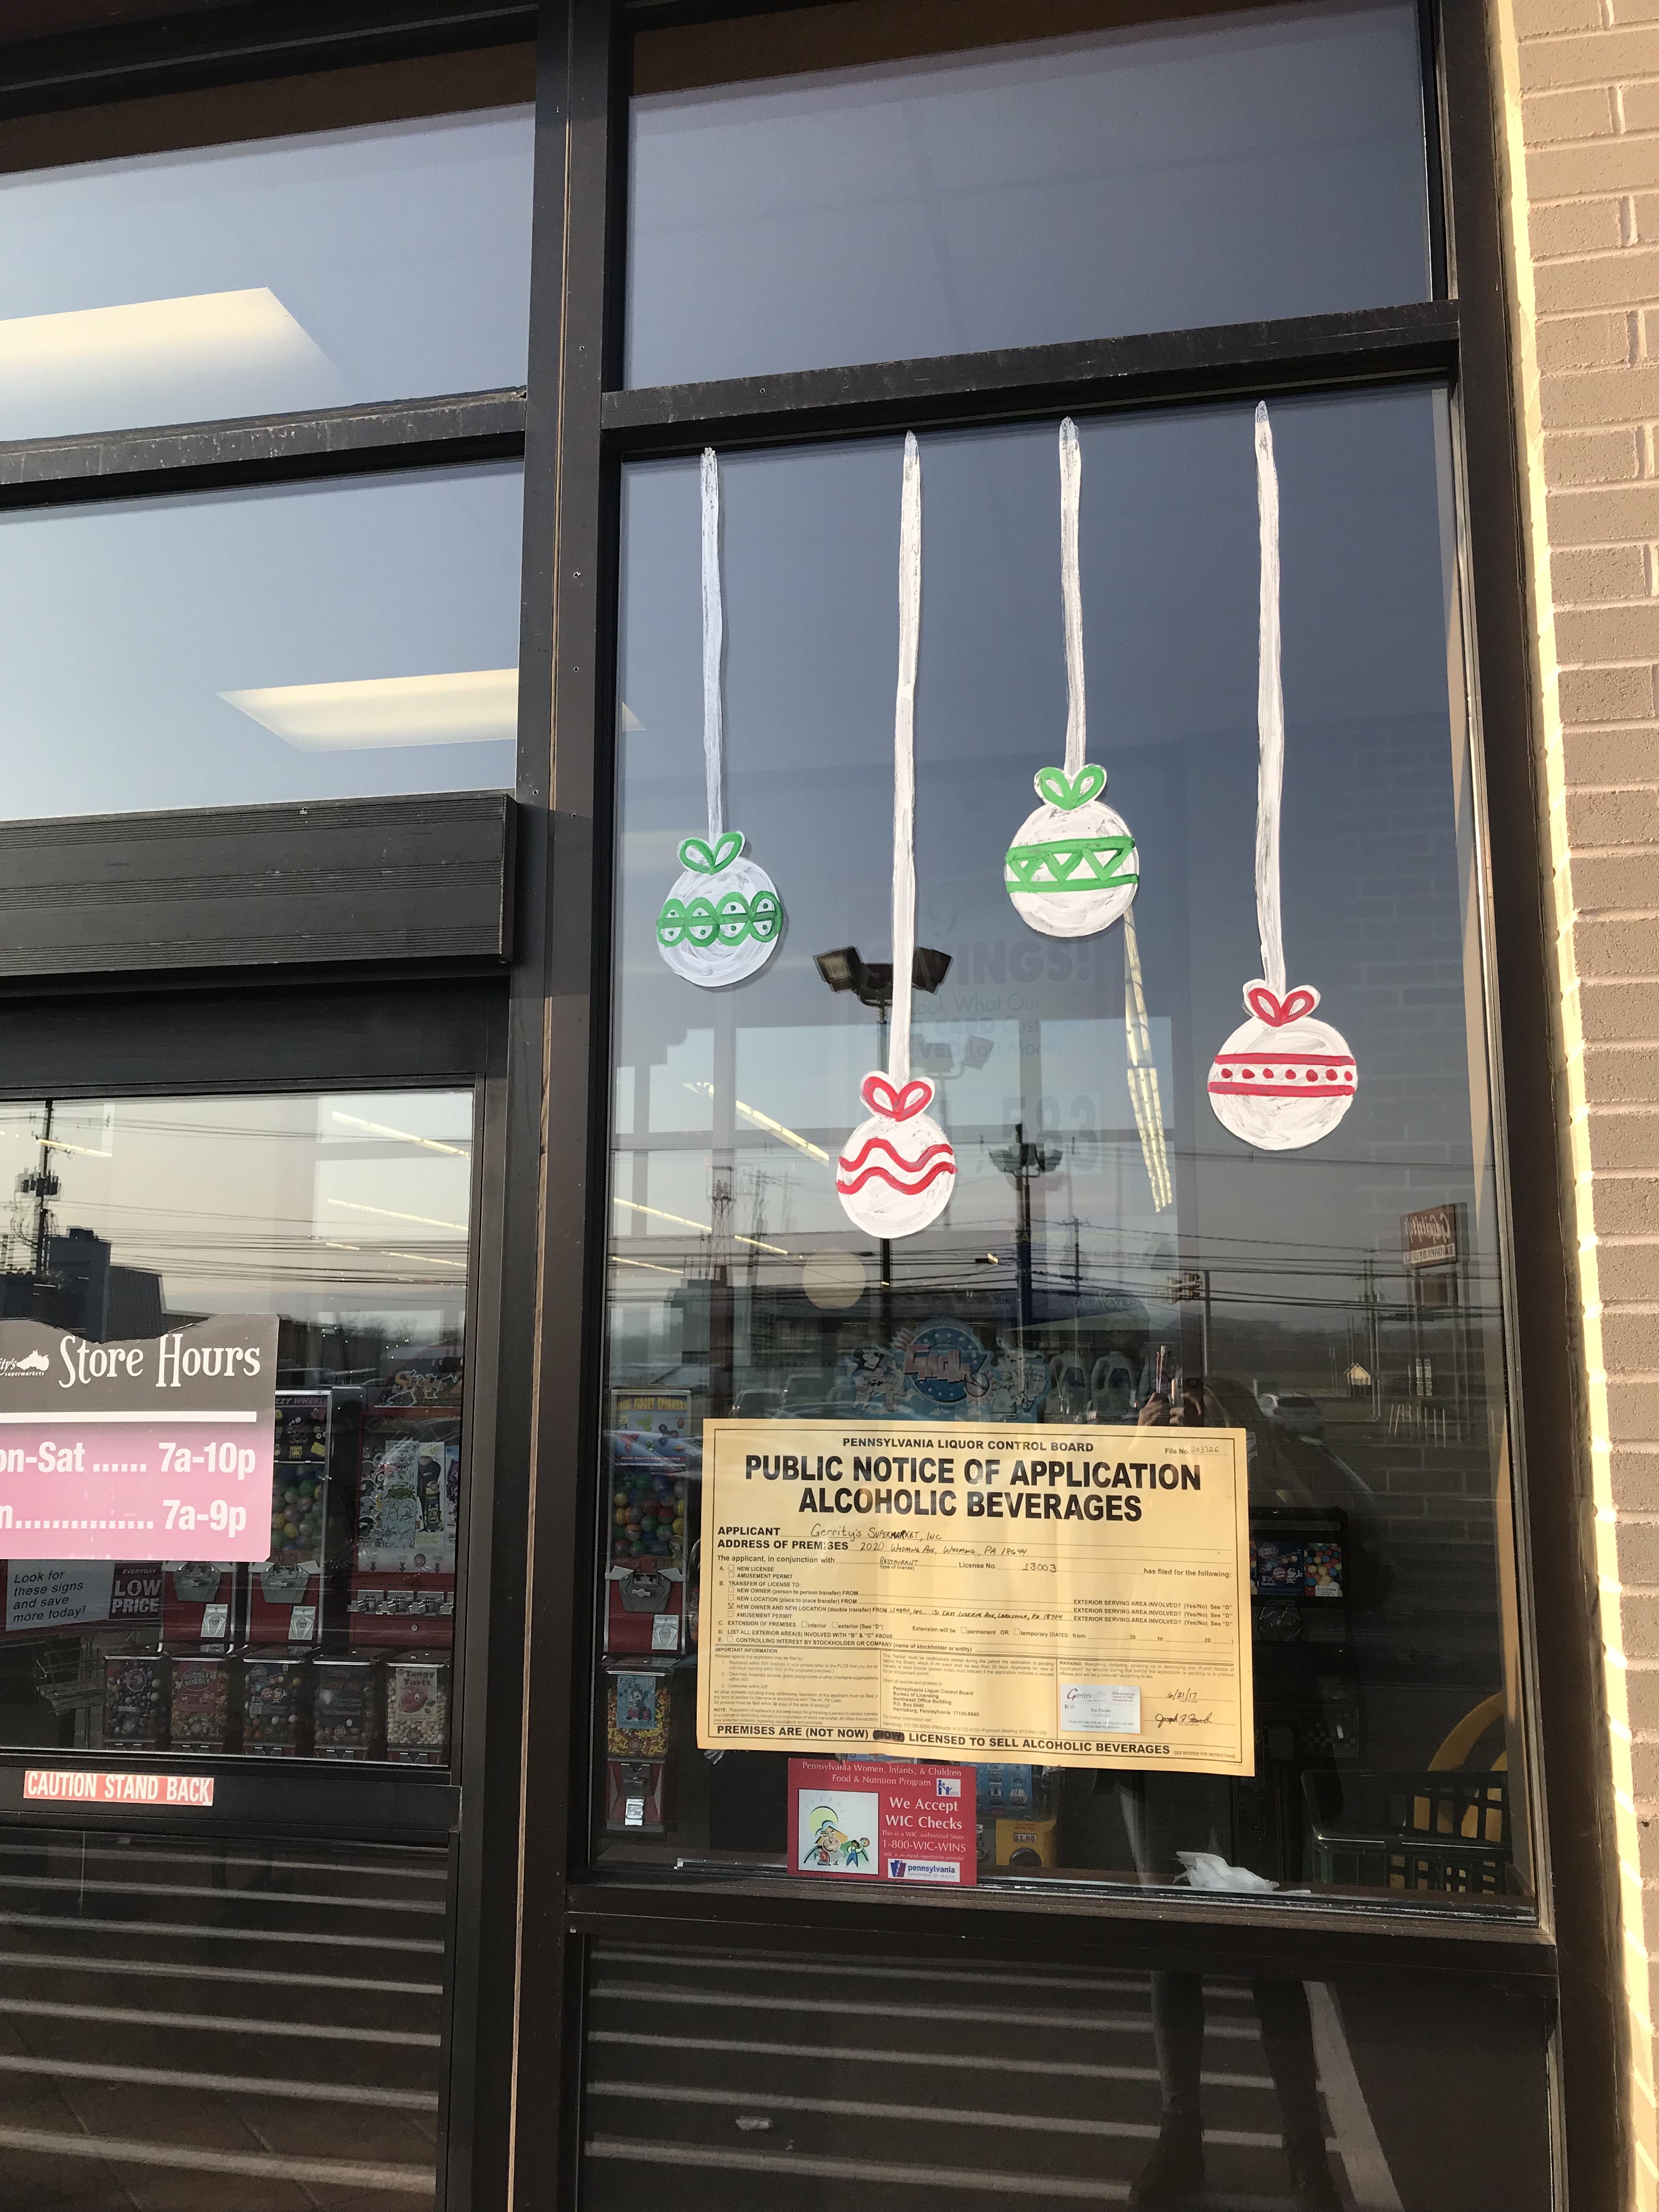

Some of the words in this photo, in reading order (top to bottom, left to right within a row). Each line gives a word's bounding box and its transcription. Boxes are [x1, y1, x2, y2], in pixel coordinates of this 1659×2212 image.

[955, 994, 1001, 1012] What
[1007, 994, 1042, 1012] Our
[59, 1335, 143, 1388] Store
[156, 1334, 260, 1387] Hours
[843, 1438, 934, 1448] PENNSYLVANIA
[938, 1440, 983, 1449] LIQUOR
[988, 1441, 1046, 1451] CONTROL
[1051, 1442, 1093, 1452] BOARD
[159, 1442, 255, 1480] 7a-10p
[746, 1455, 843, 1480] PUBLIC
[853, 1457, 954, 1483] NOTICE
[964, 1458, 1000, 1485] OF
[1010, 1460, 1200, 1491] APPLICATION
[799, 1487, 957, 1516] ALCOHOLIC
[967, 1491, 1142, 1522] BEVERAGES
[163, 1500, 246, 1538] 7a-9p
[718, 1527, 780, 1536] APPLICANT
[811, 1523, 862, 1542] Gerrity's
[718, 1540, 770, 1548] ADDRESS
[792, 1541, 848, 1550] PREMISES
[860, 1541, 884, 1551] 2020
[985, 1546, 996, 1554] PA
[14, 1572, 43, 1583] Look
[48, 1570, 65, 1581] for
[1023, 1563, 1057, 1572] 13003
[1198, 1570, 1231, 1578] following:
[14, 1585, 47, 1596] these
[52, 1581, 83, 1594] signs
[115, 1579, 161, 1596] LOW
[13, 1599, 36, 1610] and
[41, 1596, 69, 1607] save
[112, 1598, 160, 1613] PRICE
[13, 1612, 43, 1623] more
[48, 1606, 86, 1621] today!
[1167, 1688, 1197, 1700] 6/21/17
[717, 1725, 775, 1735] PREMISES
[779, 1728, 802, 1736] ARE
[806, 1728, 833, 1738] (NOT
[838, 1729, 868, 1740] NOW)
[909, 1733, 966, 1745] LICENSED
[969, 1737, 985, 1746] TO
[989, 1738, 1018, 1747] SELL
[1023, 1739, 1092, 1751] ALCOHOLIC
[1096, 1743, 1170, 1754] BEVERAGES
[802, 1762, 851, 1771] Pennsylvania
[854, 1764, 885, 1773] Women,
[889, 1765, 916, 1775] Infants,
[928, 1767, 961, 1776] Children
[28, 1772, 96, 1797] CAUTION
[105, 1774, 158, 1800] STAND
[167, 1778, 211, 1803] BACK
[832, 1774, 851, 1783] Food
[863, 1775, 896, 1785] Nutrition
[900, 1778, 930, 1787] Program
[889, 1797, 910, 1809] We
[915, 1798, 958, 1813] Accept
[885, 1815, 913, 1827] WIC
[918, 1816, 962, 1830] Checks
[883, 1839, 966, 1852] 1-800-WIC-WINS
